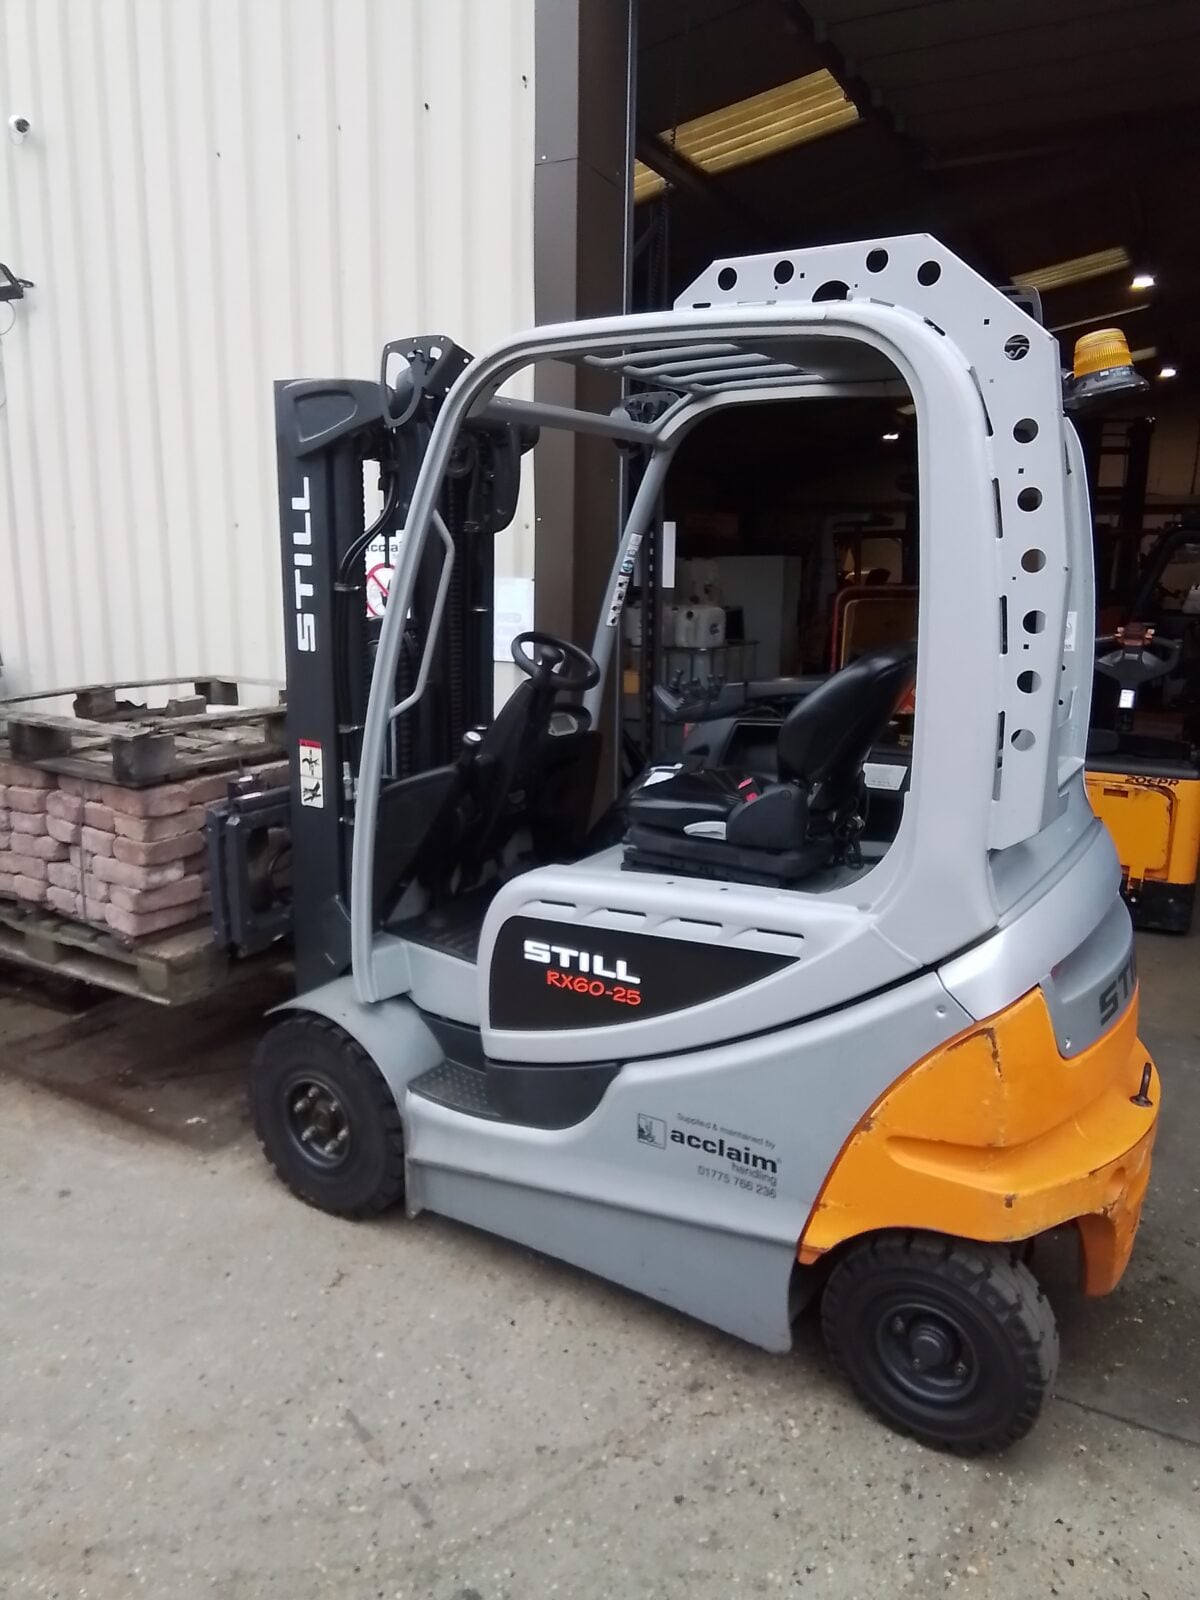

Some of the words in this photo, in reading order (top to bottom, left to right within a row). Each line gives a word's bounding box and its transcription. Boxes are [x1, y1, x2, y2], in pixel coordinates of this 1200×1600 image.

[291, 476, 316, 652] STILL
[523, 939, 641, 984] STILL
[546, 969, 641, 1005] RX60-25
[670, 1129, 777, 1174] acclaim
[764, 1139, 776, 1150] by
[697, 1165, 730, 1184] 01775
[731, 1162, 777, 1187] handling
